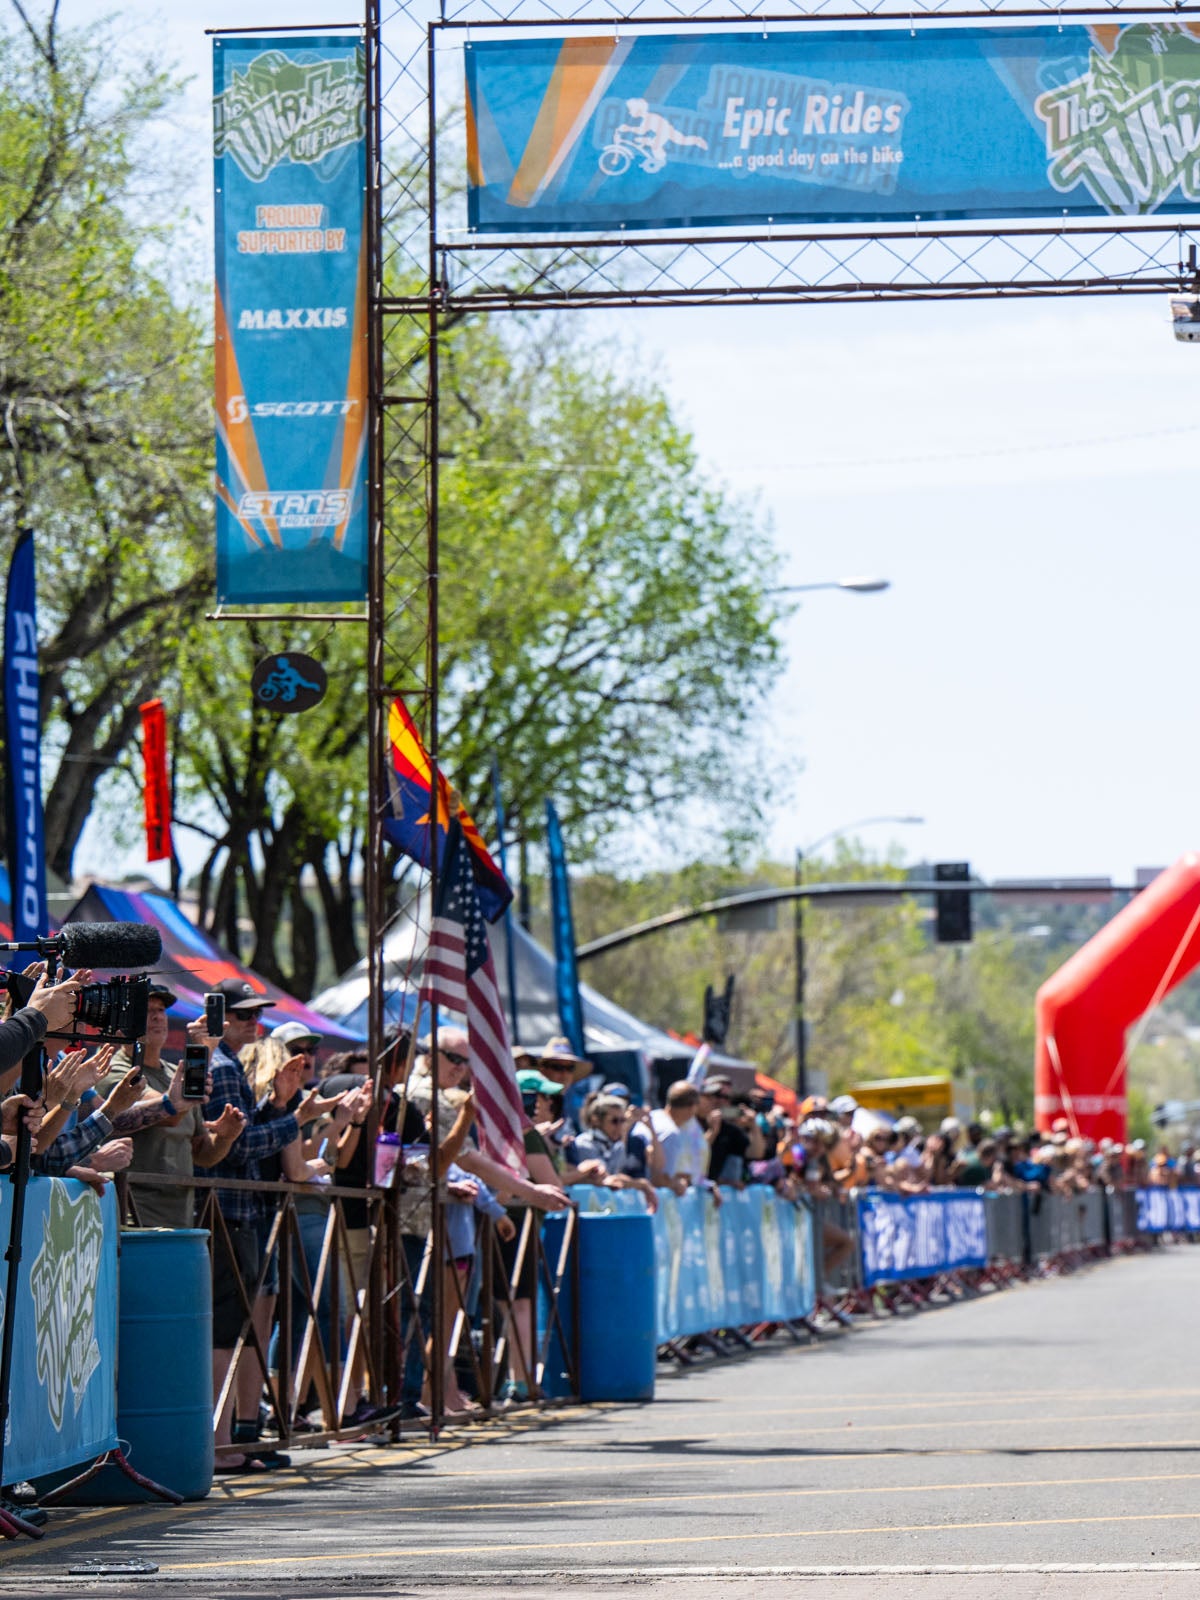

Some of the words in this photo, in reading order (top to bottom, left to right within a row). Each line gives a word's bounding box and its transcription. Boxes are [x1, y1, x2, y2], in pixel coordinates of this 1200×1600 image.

[213, 97, 246, 128] The
[722, 97, 791, 149] Epic
[803, 91, 902, 134] Rides
[1048, 93, 1109, 141] The
[216, 77, 365, 178] Whiskey
[747, 150, 783, 171] good
[788, 148, 815, 171] day
[821, 151, 840, 165] on
[844, 146, 867, 165] the
[872, 144, 904, 163] bike
[256, 206, 322, 228] PROUDLY
[238, 230, 322, 252] SUPPORTED
[325, 229, 345, 251] BY
[238, 306, 348, 329] MAXXIS
[250, 399, 359, 417] SCOTT
